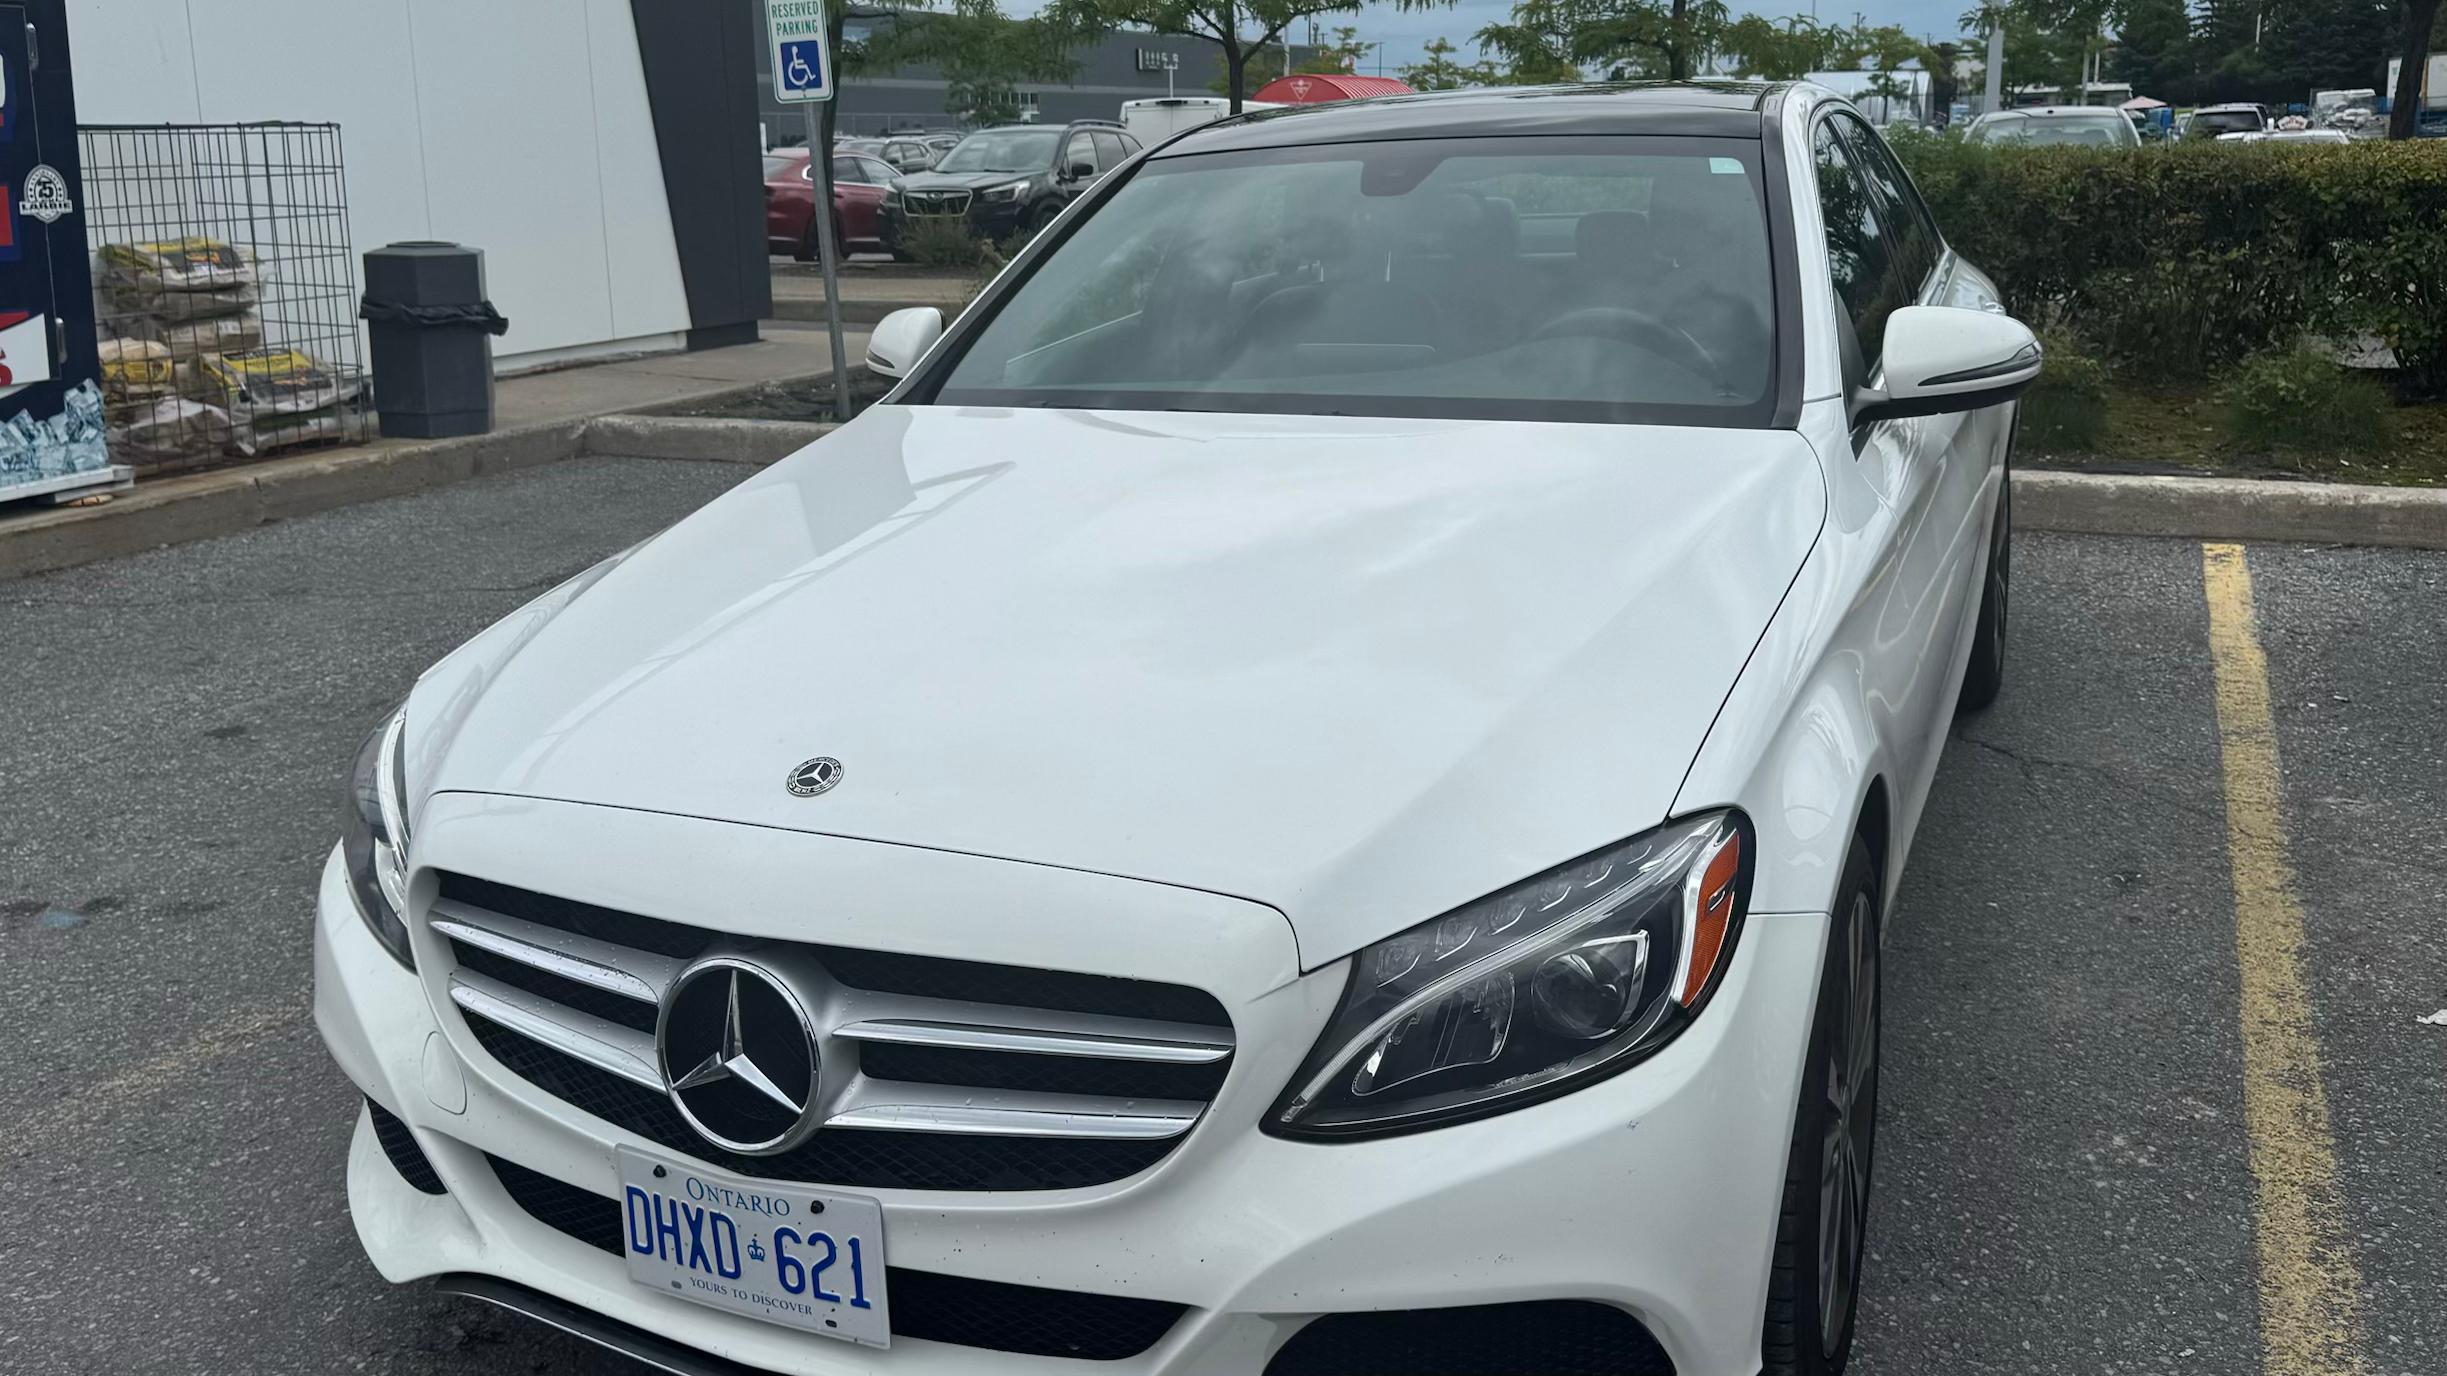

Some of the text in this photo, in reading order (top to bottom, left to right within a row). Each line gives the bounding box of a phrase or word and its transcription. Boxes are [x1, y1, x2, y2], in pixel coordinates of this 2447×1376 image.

[771, 1, 819, 19] RESERVED
[776, 20, 818, 36] PARKING
[686, 1177, 790, 1217] ONTARIO
[626, 1185, 871, 1309] DHXD 621
[689, 1276, 813, 1316] YOURS TO DISCOVER
